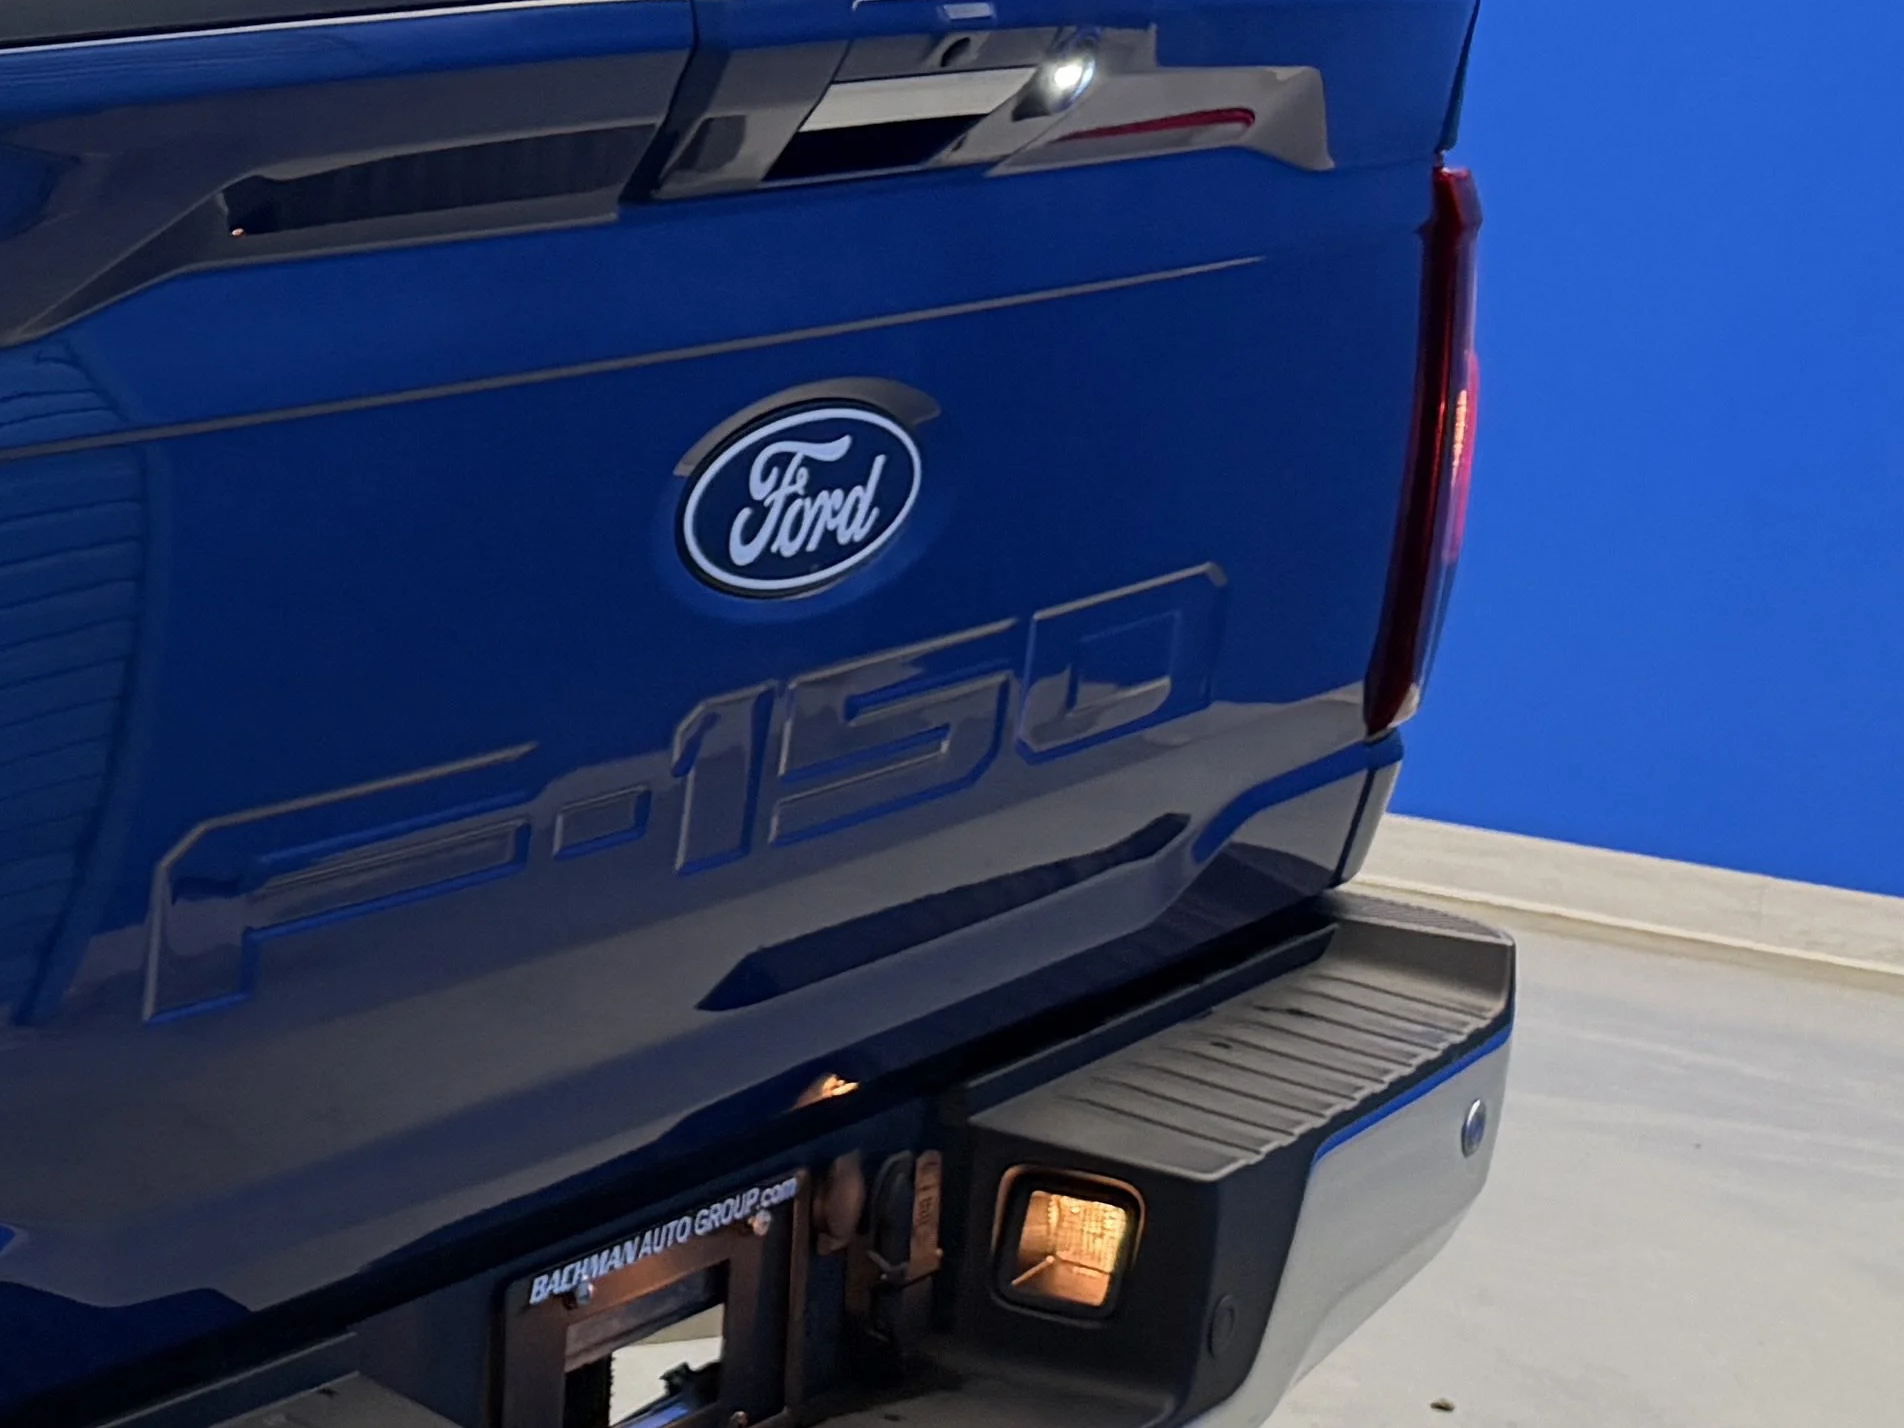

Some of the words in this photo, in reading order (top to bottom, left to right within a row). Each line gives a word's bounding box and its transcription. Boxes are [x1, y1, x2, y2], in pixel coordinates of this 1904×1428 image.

[728, 432, 886, 565] Ford
[142, 561, 1229, 1025] F-150
[528, 1236, 641, 1305] BACHMAN
[637, 1215, 691, 1259] AUTO
[693, 1176, 799, 1237] GROUP.com
